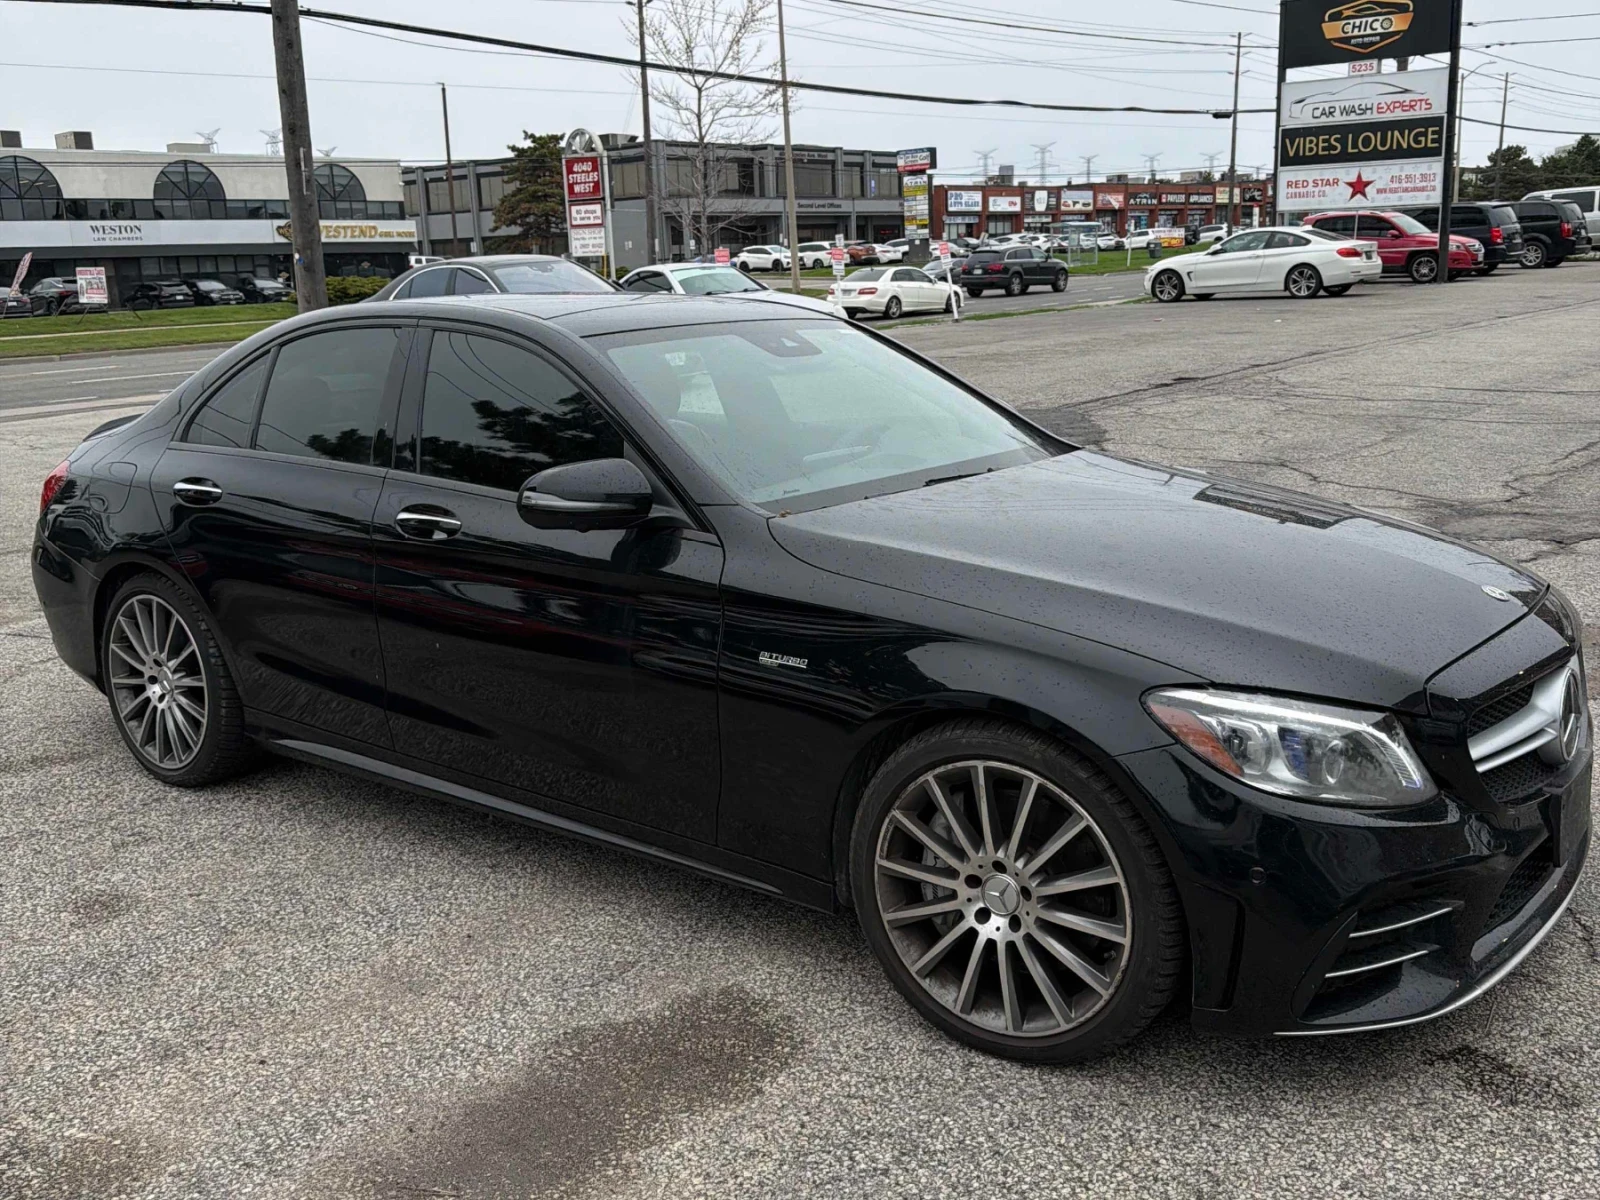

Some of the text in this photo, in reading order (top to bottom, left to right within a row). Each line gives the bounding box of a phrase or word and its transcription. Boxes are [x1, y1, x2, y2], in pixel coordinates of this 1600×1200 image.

[1341, 17, 1393, 35] CHICO
[1351, 62, 1374, 73] 5235
[1311, 98, 1433, 119] CAR WASH EXPERTS
[1285, 127, 1440, 157] VIBES LOUNGE
[573, 161, 593, 172] 4040
[568, 172, 598, 184] STEELES
[1286, 177, 1340, 189] RED STAR
[1389, 172, 1436, 184] 416-551-3913
[573, 183, 594, 194] WEST
[1167, 193, 1186, 203] PAYLESS
[1189, 194, 1213, 203] APPLIANCES
[1286, 190, 1328, 200] CANNABIS CO.
[90, 224, 142, 235] WESTON
[760, 650, 808, 666] BITURBO
